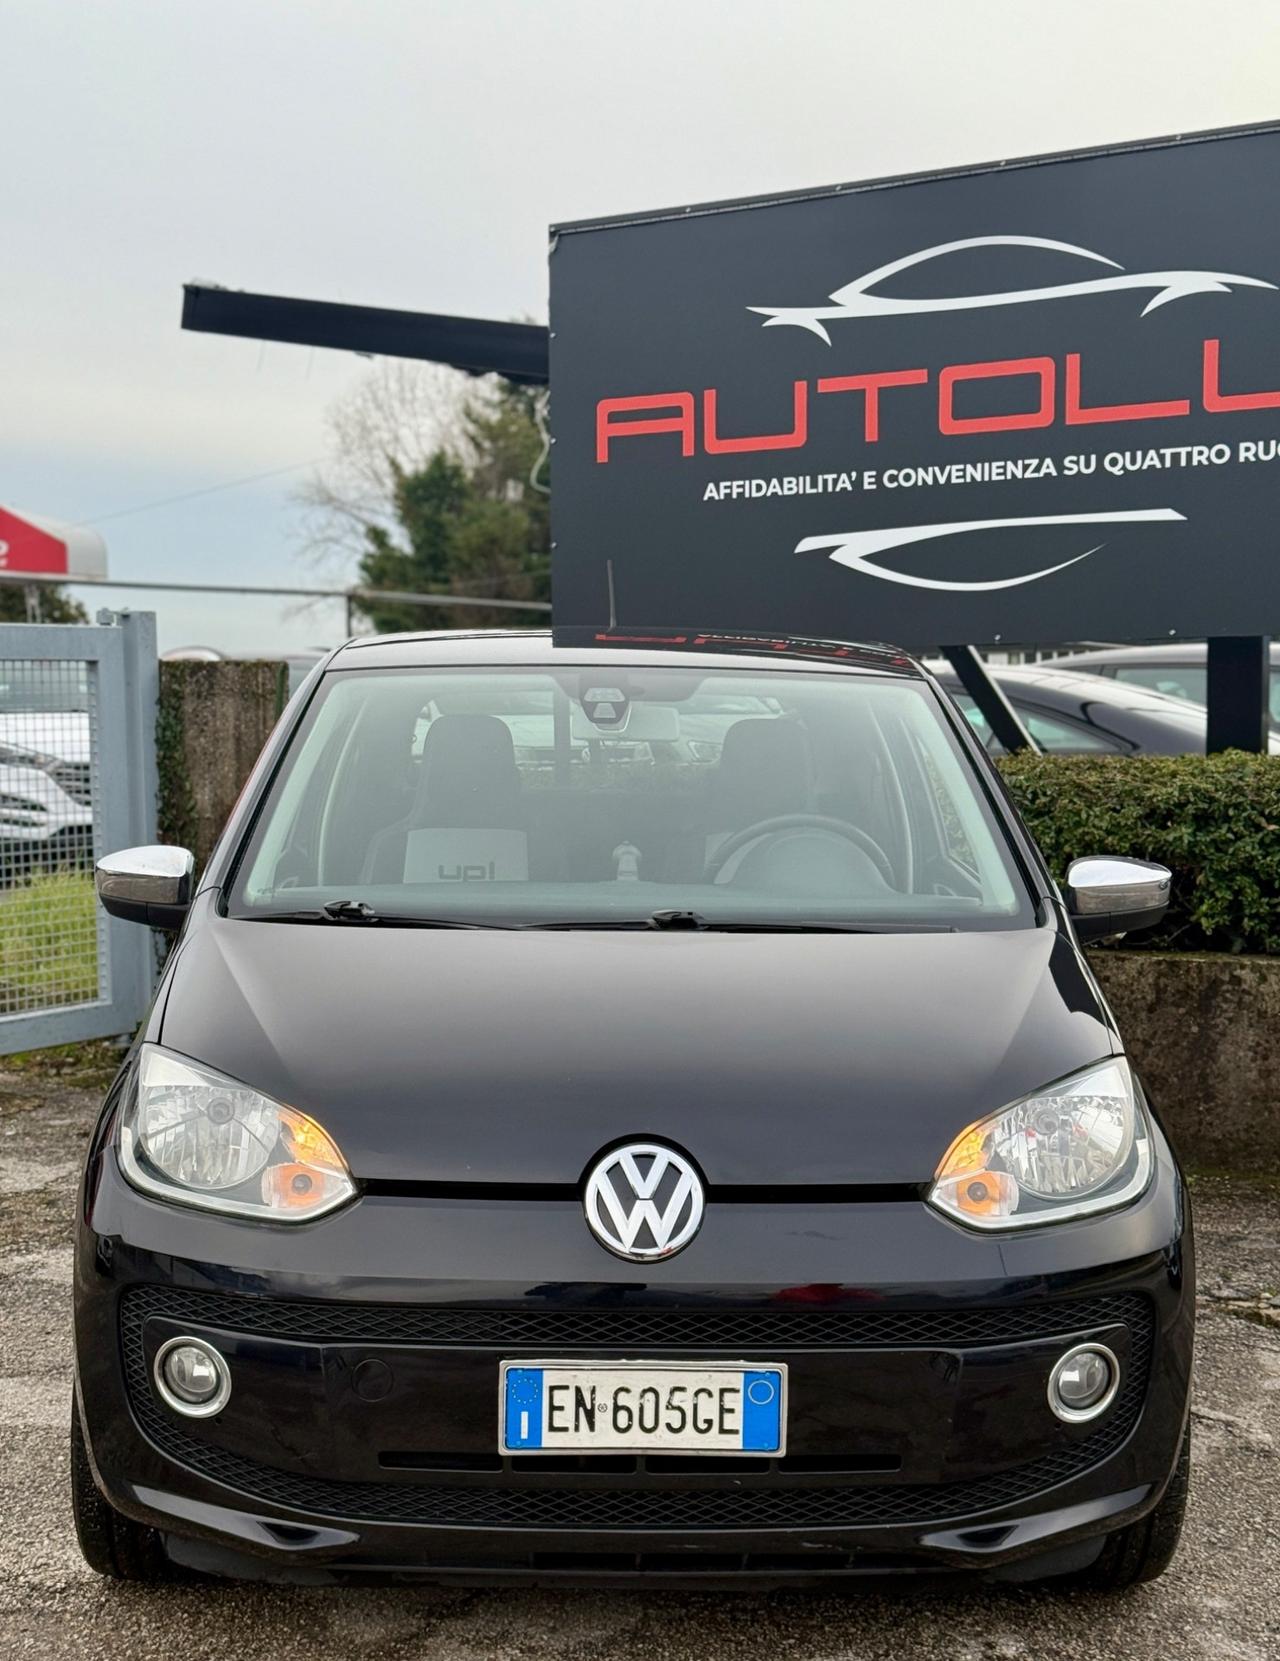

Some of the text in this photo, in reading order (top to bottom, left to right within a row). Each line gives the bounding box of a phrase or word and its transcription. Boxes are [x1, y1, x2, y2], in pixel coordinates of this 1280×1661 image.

[863, 470, 877, 490] E
[882, 457, 1058, 489] CONVENIENZA
[1063, 453, 1097, 476] SU
[1103, 443, 1231, 476] QUATTRO
[1238, 439, 1280, 463] RU
